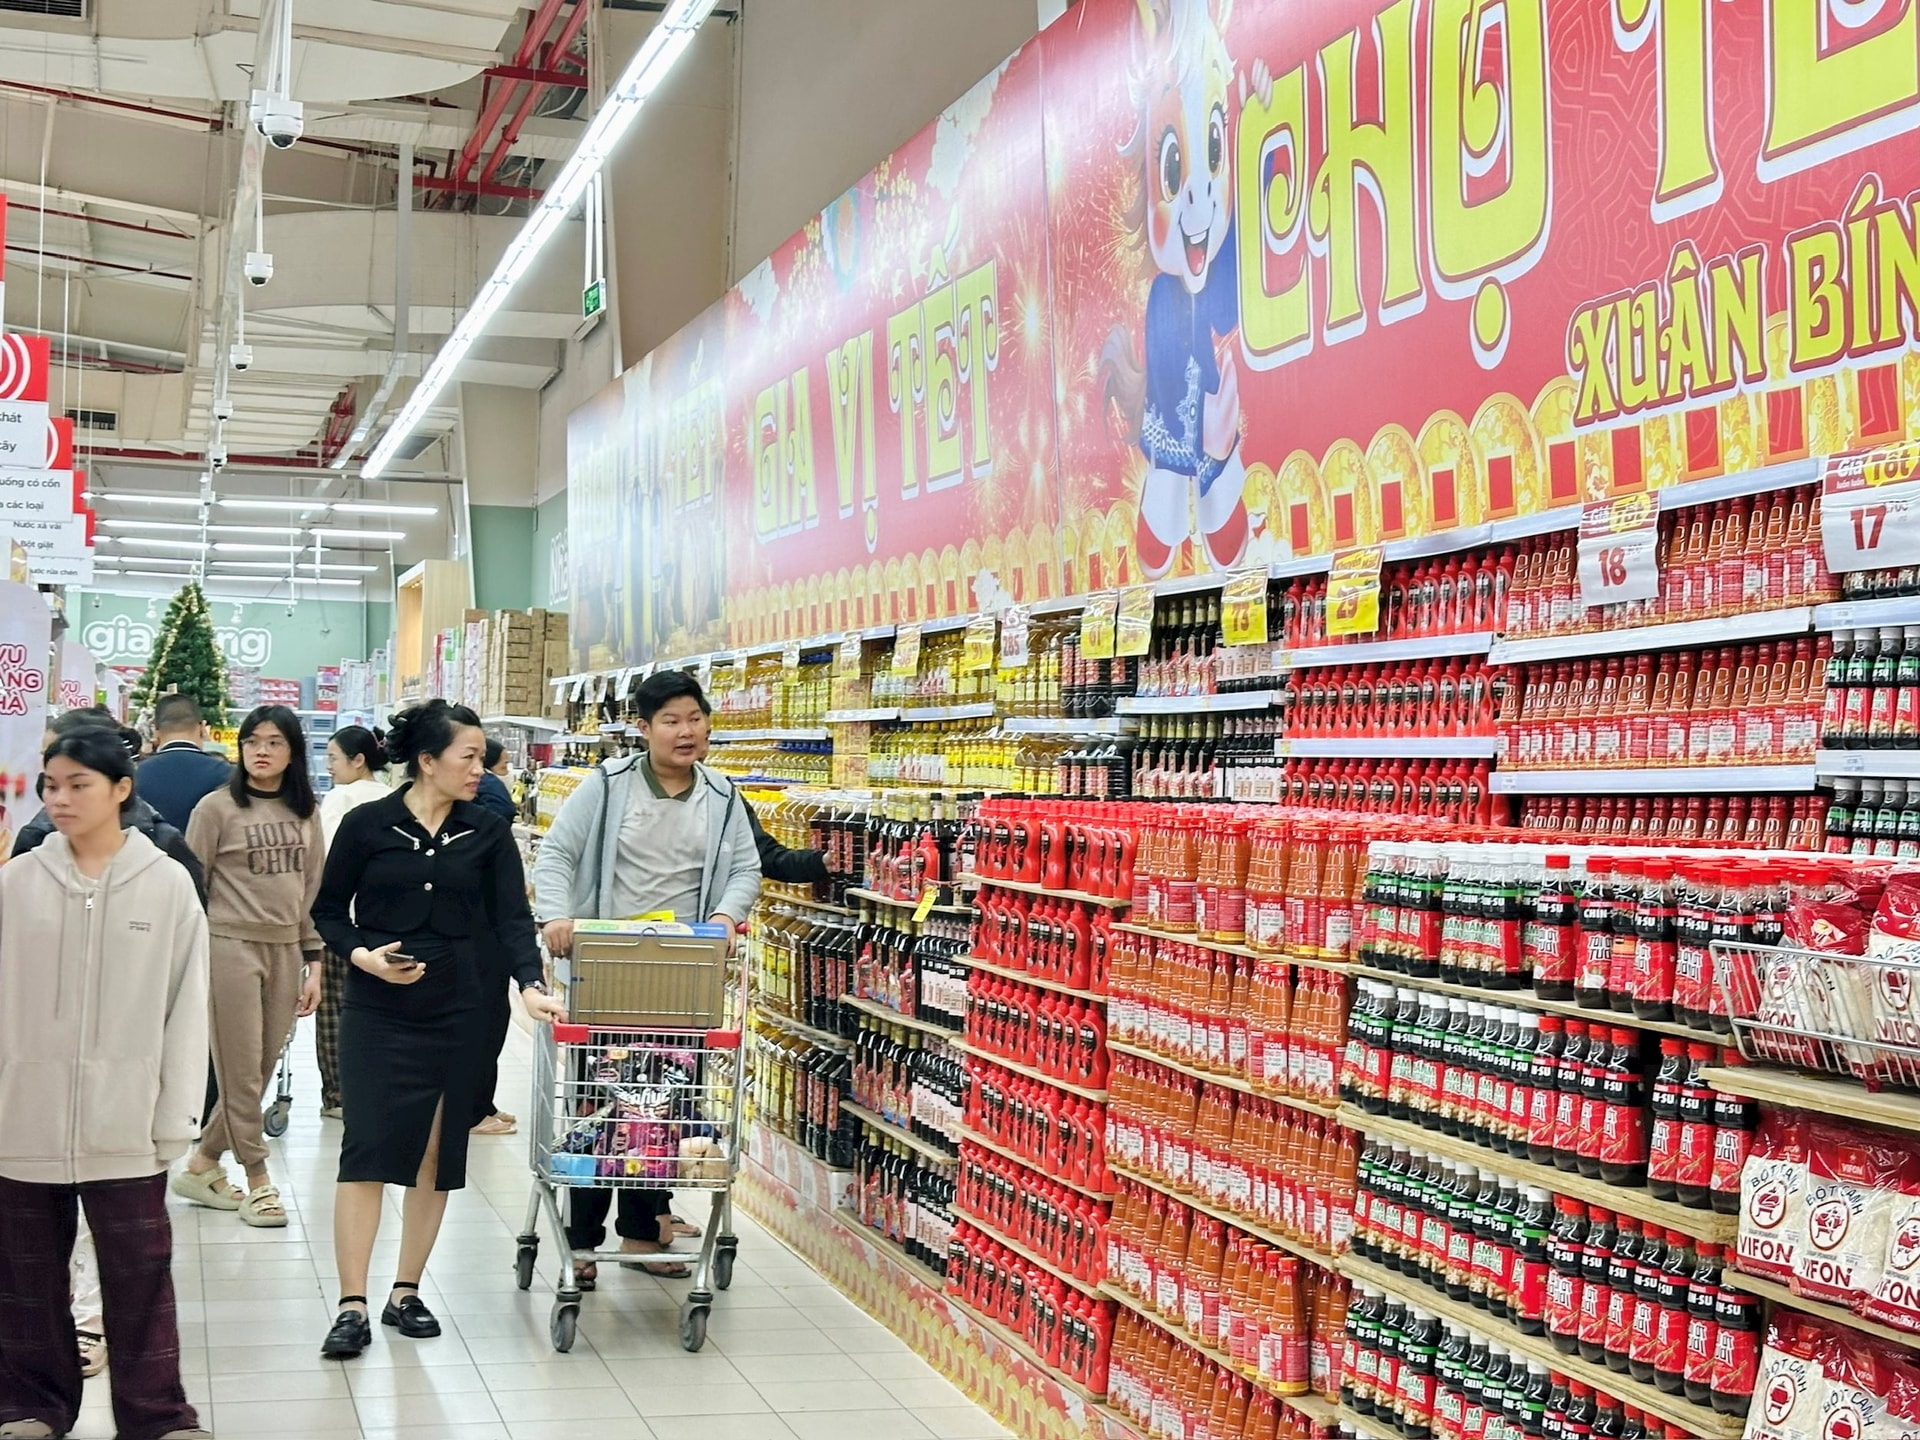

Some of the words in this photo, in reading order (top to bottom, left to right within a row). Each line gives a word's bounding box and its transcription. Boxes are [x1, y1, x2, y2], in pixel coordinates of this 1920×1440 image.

[1568, 241, 1767, 427] XUÂN
[753, 366, 819, 545] GIA
[826, 329, 878, 553] VỊ
[887, 206, 998, 500] TẾT
[1850, 503, 1887, 551] 17
[1598, 546, 1627, 588] 18
[1233, 601, 1250, 632] 73
[86, 616, 150, 661] gia
[222, 630, 268, 662] ng
[241, 821, 306, 849] HOLY
[248, 847, 306, 875] CHIC
[1740, 1234, 1794, 1263] VIFON
[1850, 1391, 1875, 1427] CANH
